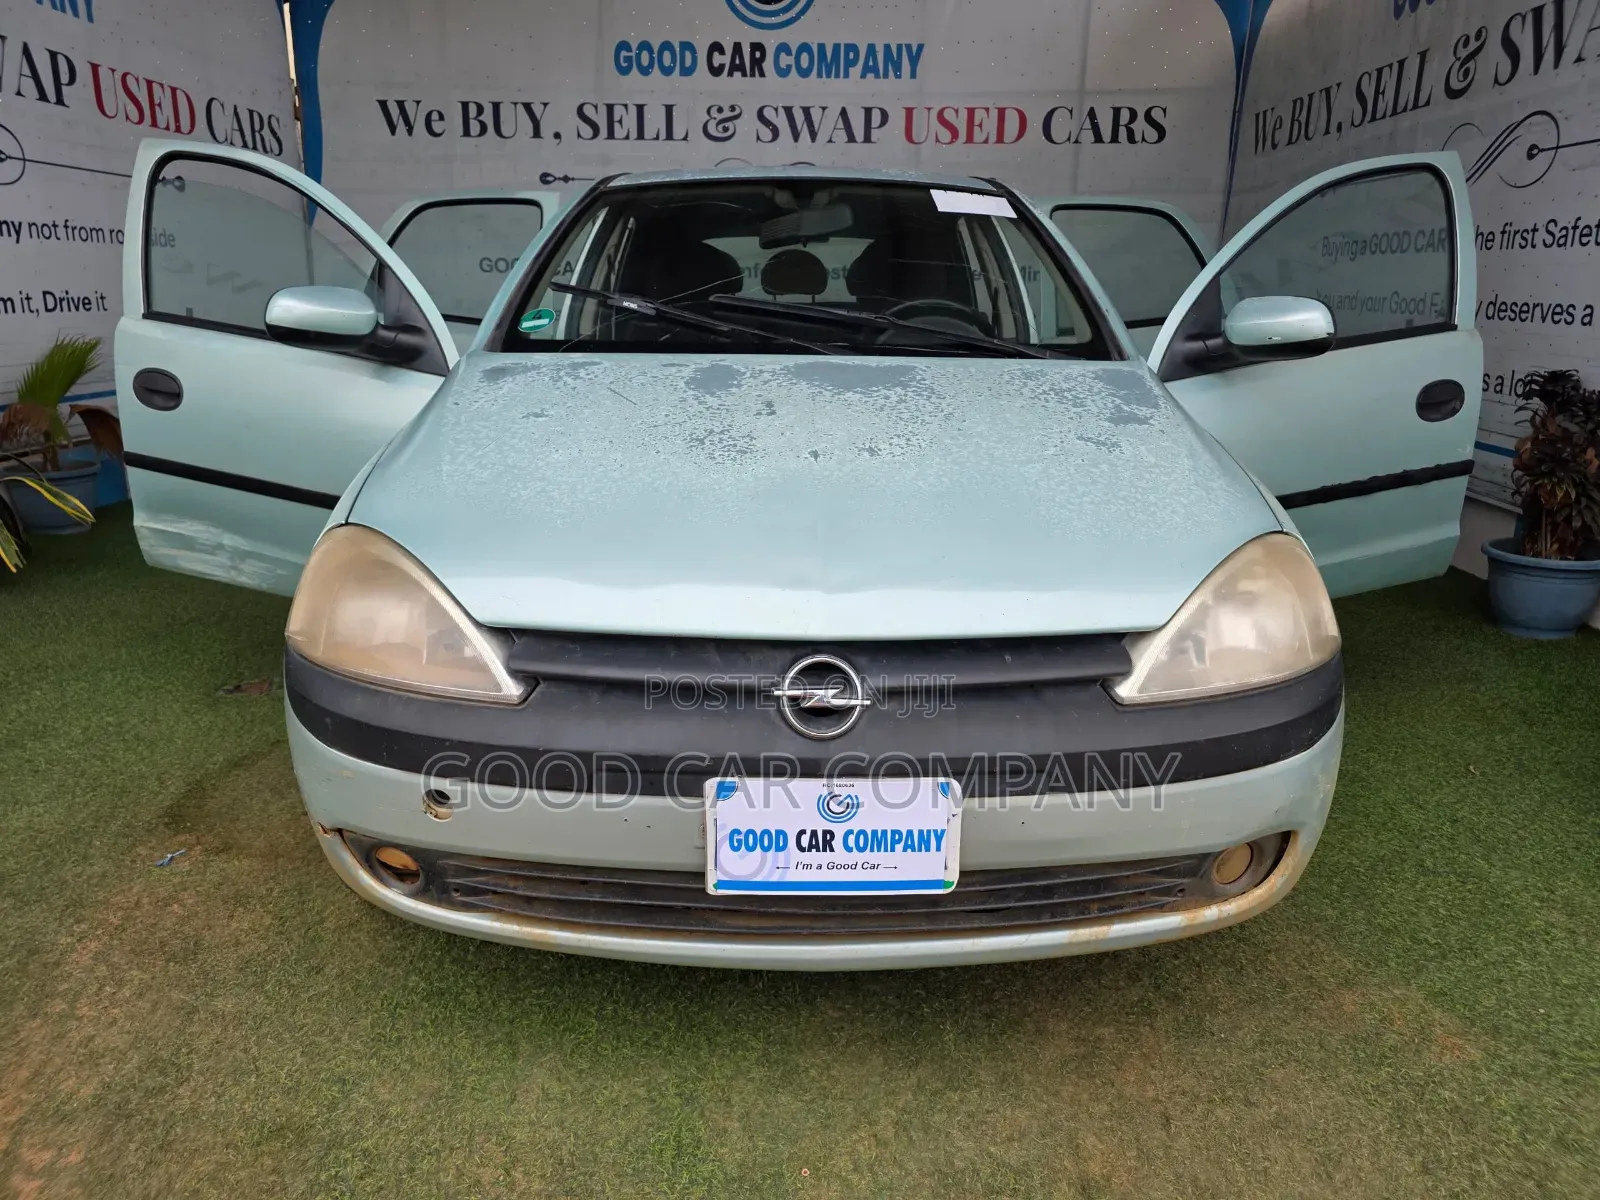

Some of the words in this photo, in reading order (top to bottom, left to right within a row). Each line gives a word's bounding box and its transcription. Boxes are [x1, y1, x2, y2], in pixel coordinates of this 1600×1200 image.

[614, 40, 697, 77] GOOD
[706, 41, 766, 78] CAR
[773, 42, 925, 80] COMPANY
[0, 34, 77, 109] AP
[87, 60, 197, 136] USED
[205, 96, 284, 157] CARS
[1253, 107, 1283, 155] We
[1286, 82, 1342, 142] BUY,
[1350, 48, 1434, 128] SELL
[1444, 26, 1489, 100] &
[376, 99, 446, 138] We
[457, 100, 562, 146] BUY,
[575, 102, 689, 142] SELL
[702, 104, 743, 143] &
[755, 105, 889, 144] SWAP
[902, 106, 1028, 145] USED
[1041, 105, 1168, 145] CARS
[28, 220, 61, 241] not
[63, 219, 106, 243] from
[1321, 235, 1359, 263] Buying
[1360, 240, 1368, 256] a
[1369, 230, 1411, 256] GOOD
[1414, 228, 1446, 253] CAR
[1499, 222, 1539, 250] first
[19, 291, 40, 317] it,
[42, 290, 92, 313] Drive
[95, 291, 108, 312] it
[1336, 289, 1359, 312] and
[1359, 295, 1387, 316] your
[1388, 290, 1427, 315] Good
[1485, 294, 1577, 326] deserves
[1580, 304, 1594, 327] a
[1494, 374, 1505, 395] a
[728, 828, 789, 853] GOOD
[795, 829, 836, 853] CAR
[842, 829, 946, 853] COMPANY
[795, 861, 813, 871] I'm
[826, 861, 858, 871] Good
[861, 861, 881, 871] Car
